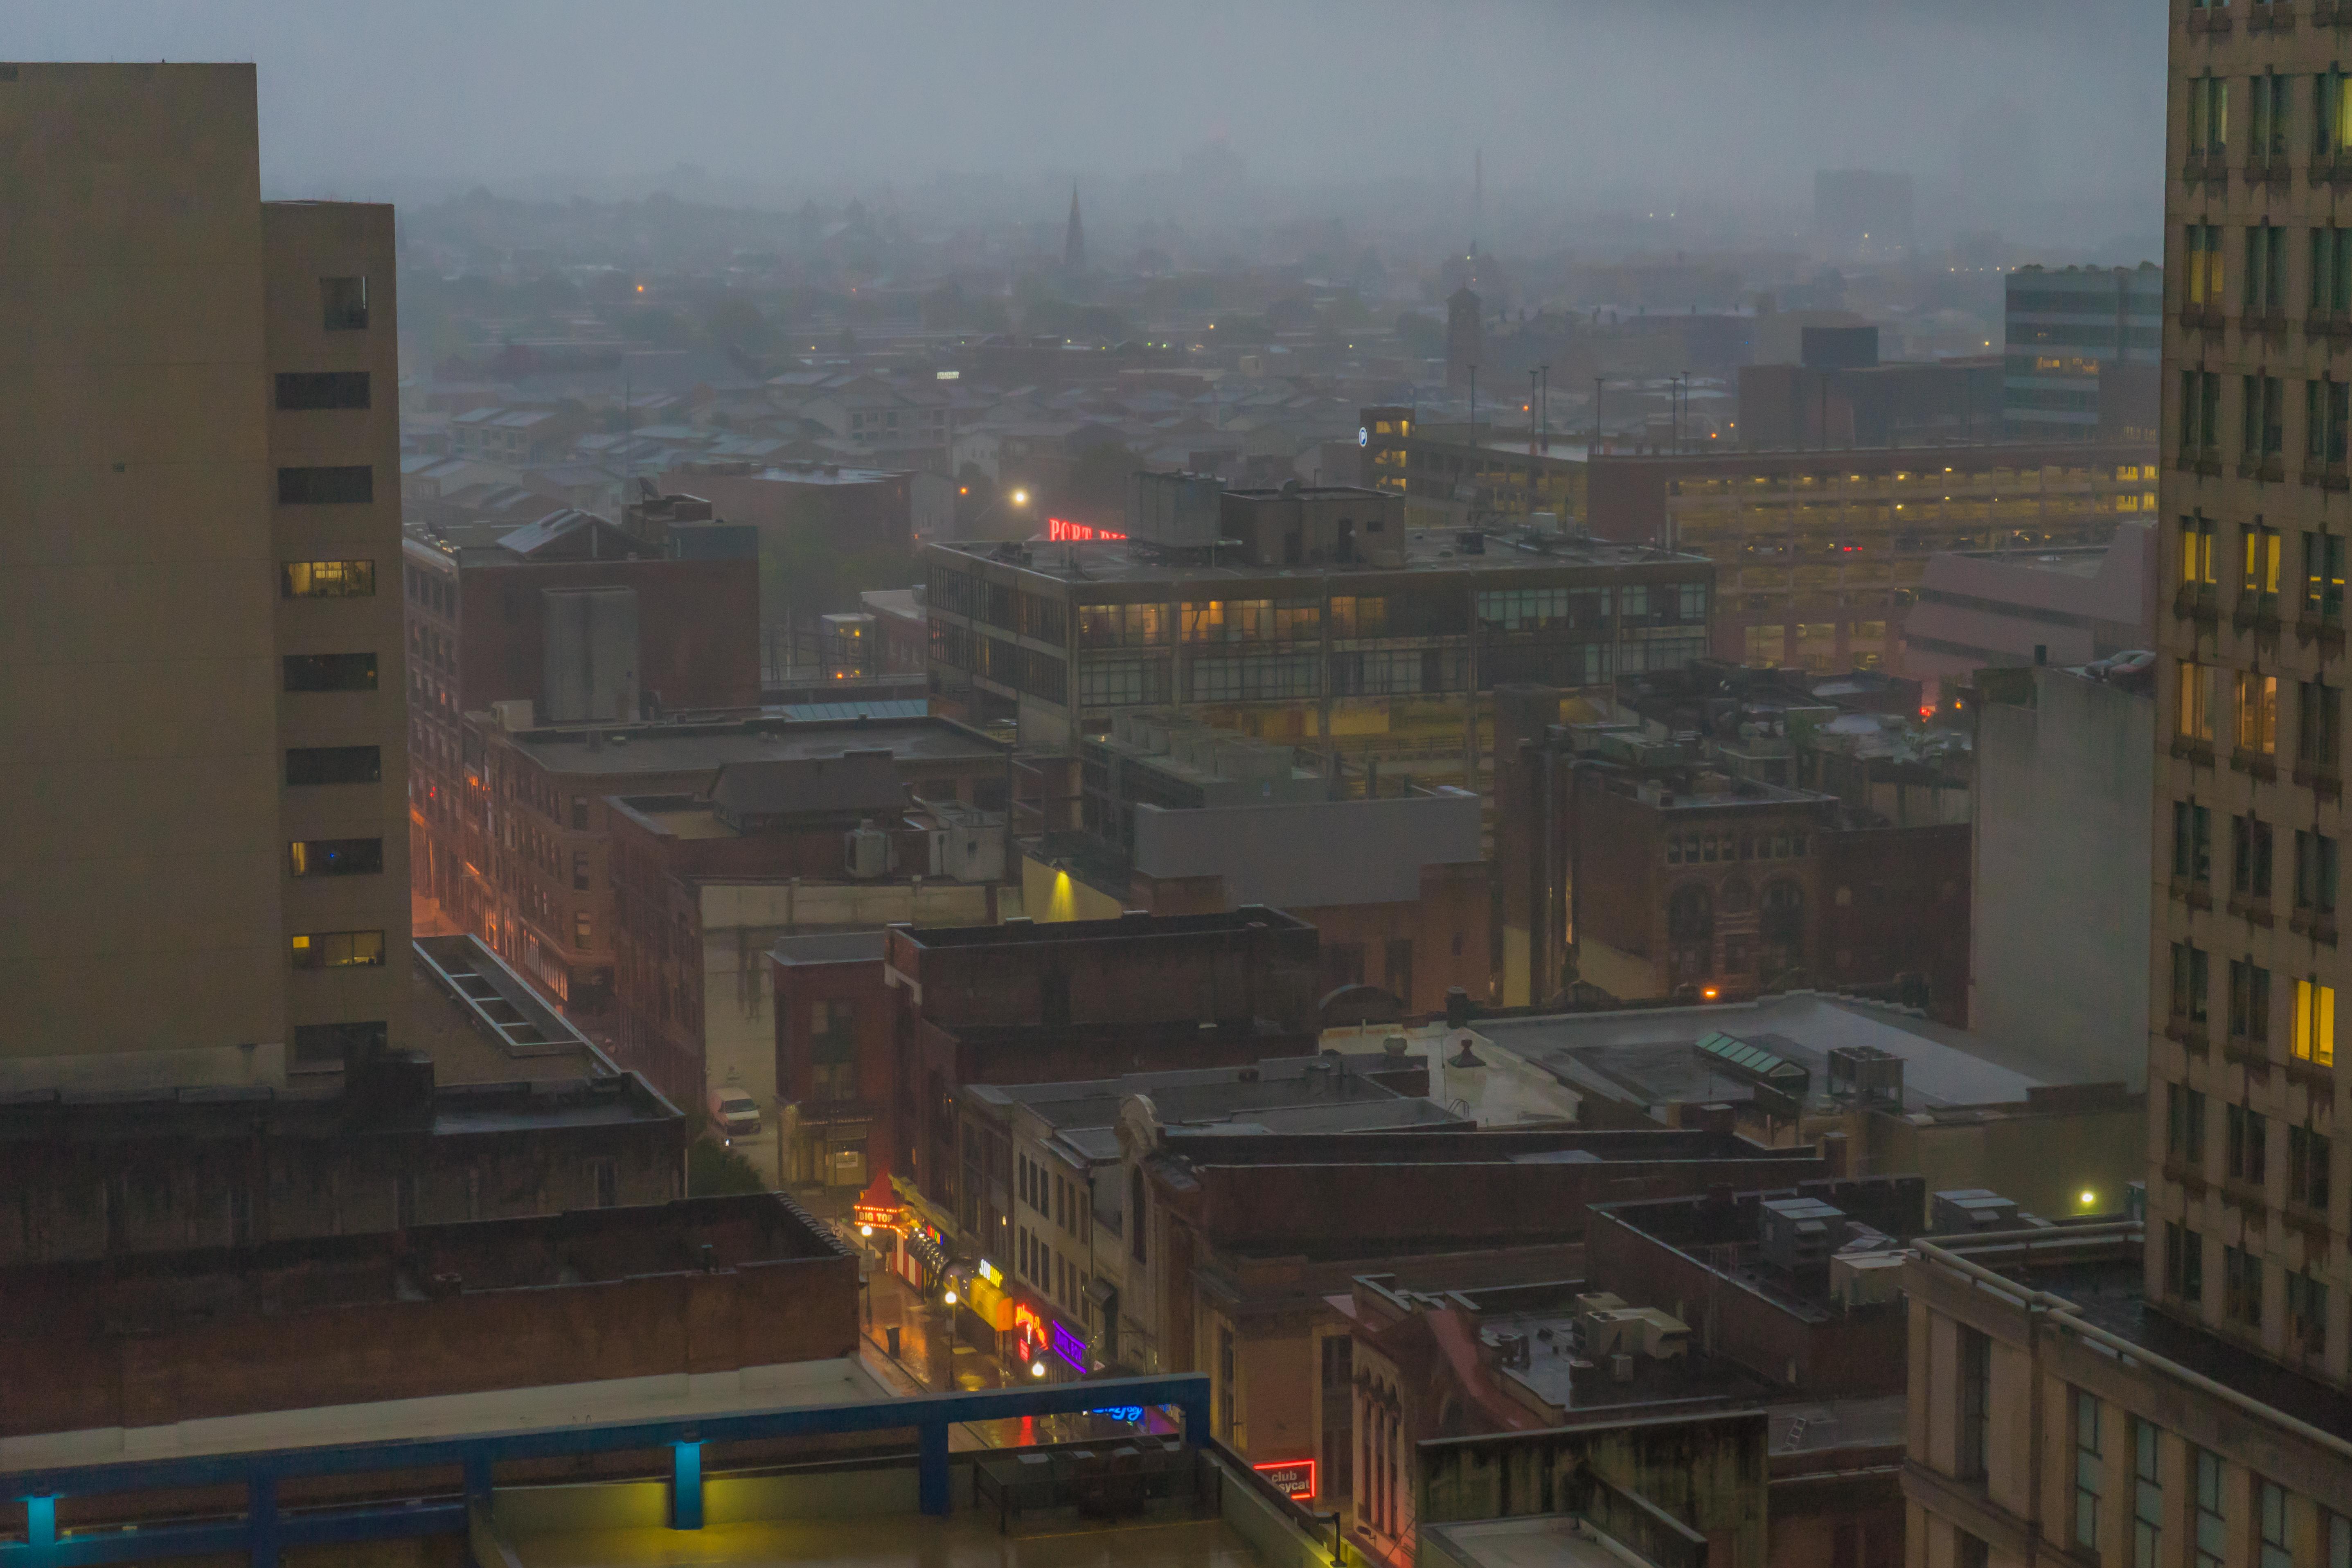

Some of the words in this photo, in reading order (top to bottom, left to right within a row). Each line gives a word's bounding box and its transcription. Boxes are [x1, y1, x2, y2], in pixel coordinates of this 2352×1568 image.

[859, 1212, 874, 1221] BIG
[876, 1213, 893, 1223] TOP
[979, 1259, 1003, 1288] SUBWAY
[1271, 1470, 1297, 1482] club
[1278, 1480, 1310, 1493] sycat
